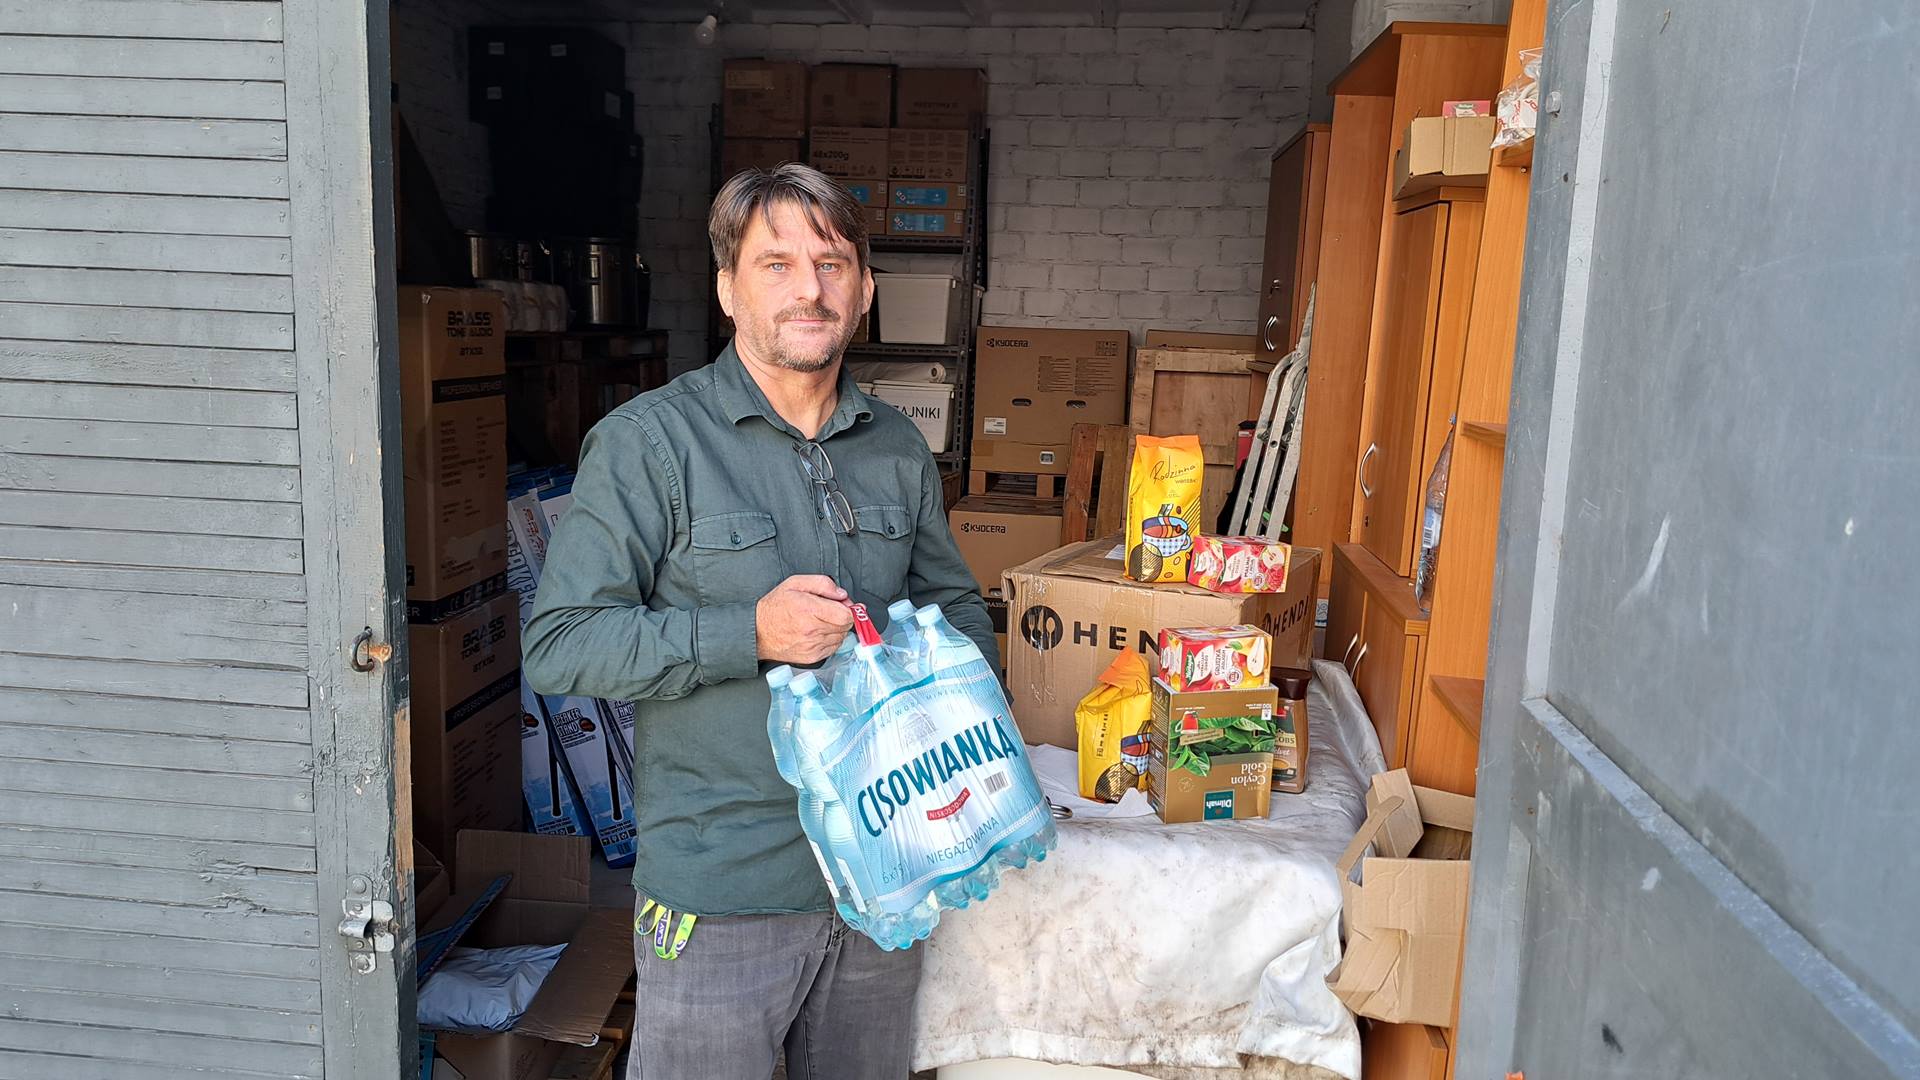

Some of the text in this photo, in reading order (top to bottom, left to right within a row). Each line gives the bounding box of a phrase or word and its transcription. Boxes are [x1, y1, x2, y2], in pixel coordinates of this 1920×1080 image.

[894, 405, 940, 419] AJNIKI
[970, 524, 1006, 534] KYOCERA
[1272, 596, 1309, 638] HENDI
[1073, 620, 1161, 656] HEN
[857, 716, 1019, 838] CISOWIANKA
[1240, 762, 1267, 775] Gold
[1230, 771, 1266, 786] Ceylon
[1206, 799, 1232, 809] Dilmah
[926, 816, 1000, 866] NIEGAZOWANA
[656, 922, 666, 945] PLAY
